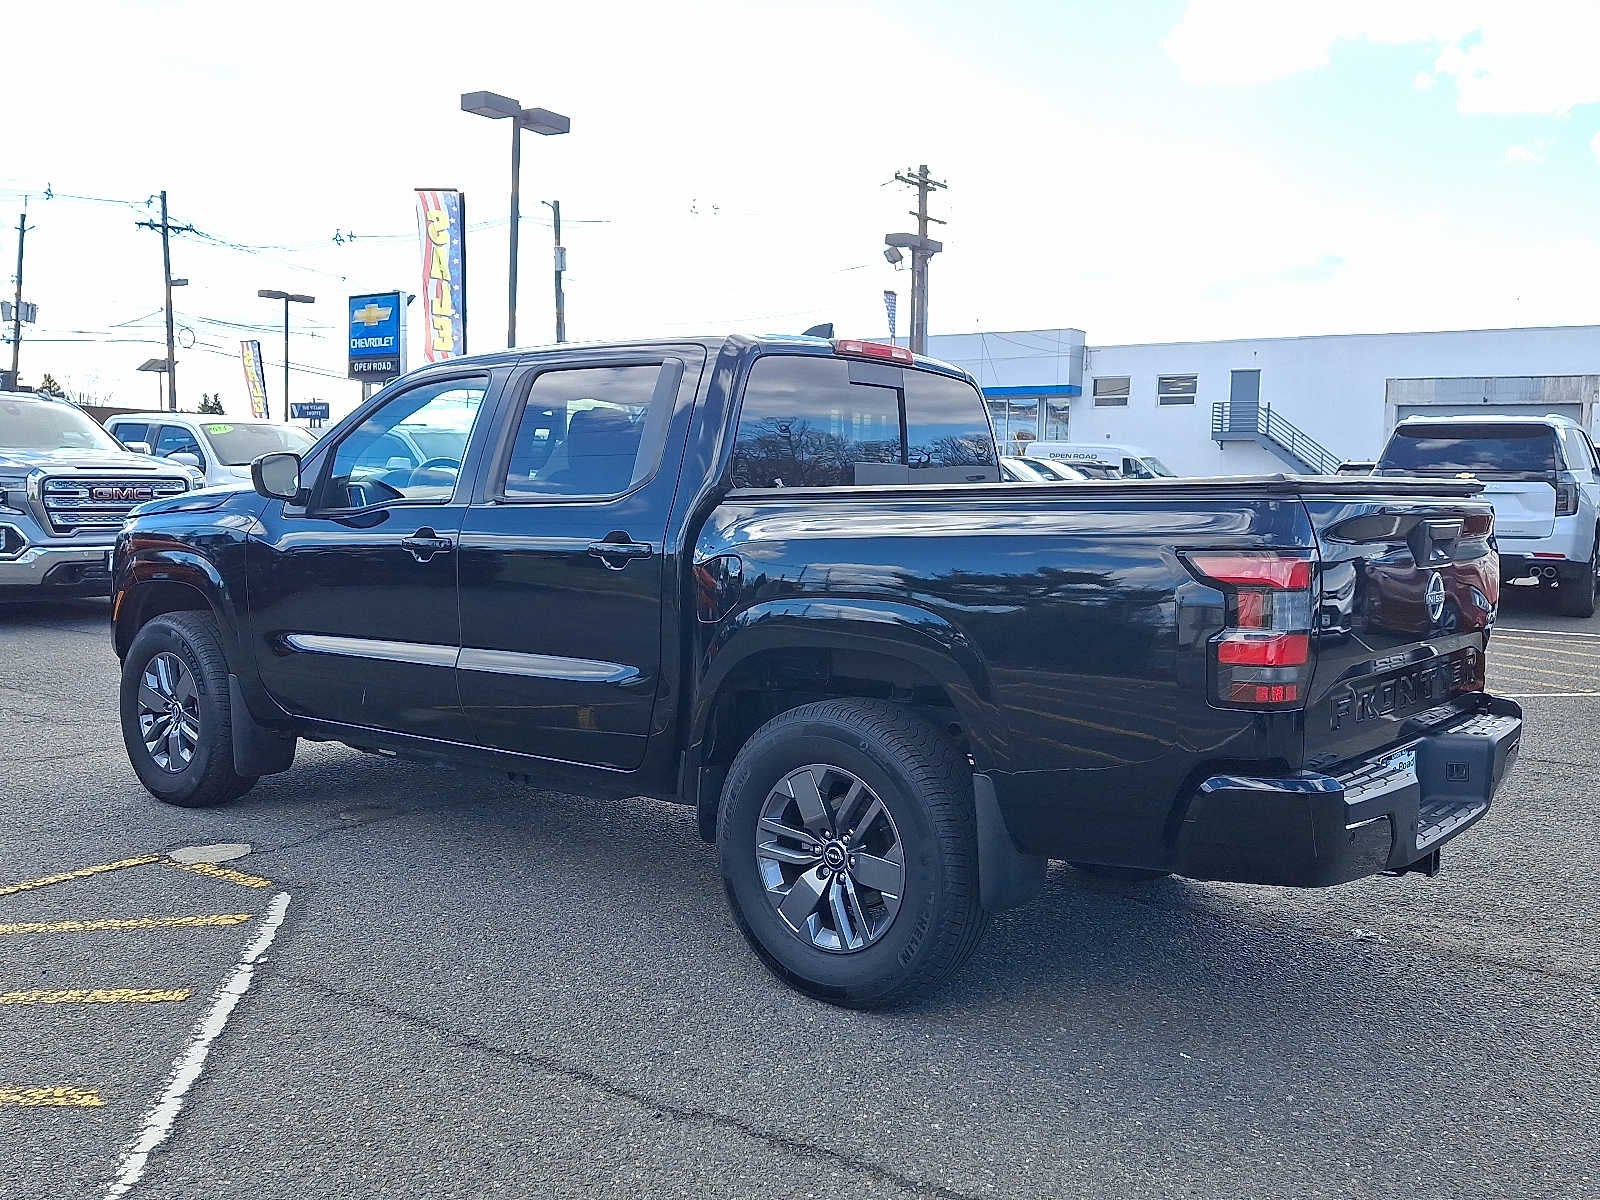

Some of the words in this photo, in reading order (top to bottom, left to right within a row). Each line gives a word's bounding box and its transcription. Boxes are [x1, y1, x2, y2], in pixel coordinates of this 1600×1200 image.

[350, 336, 394, 349] CHEVROLET
[354, 362, 372, 372] OPEN
[372, 361, 392, 371] ROAD
[92, 487, 152, 500] GMC
[1428, 594, 1444, 603] NISS
[1329, 649, 1477, 732] FRONTIER
